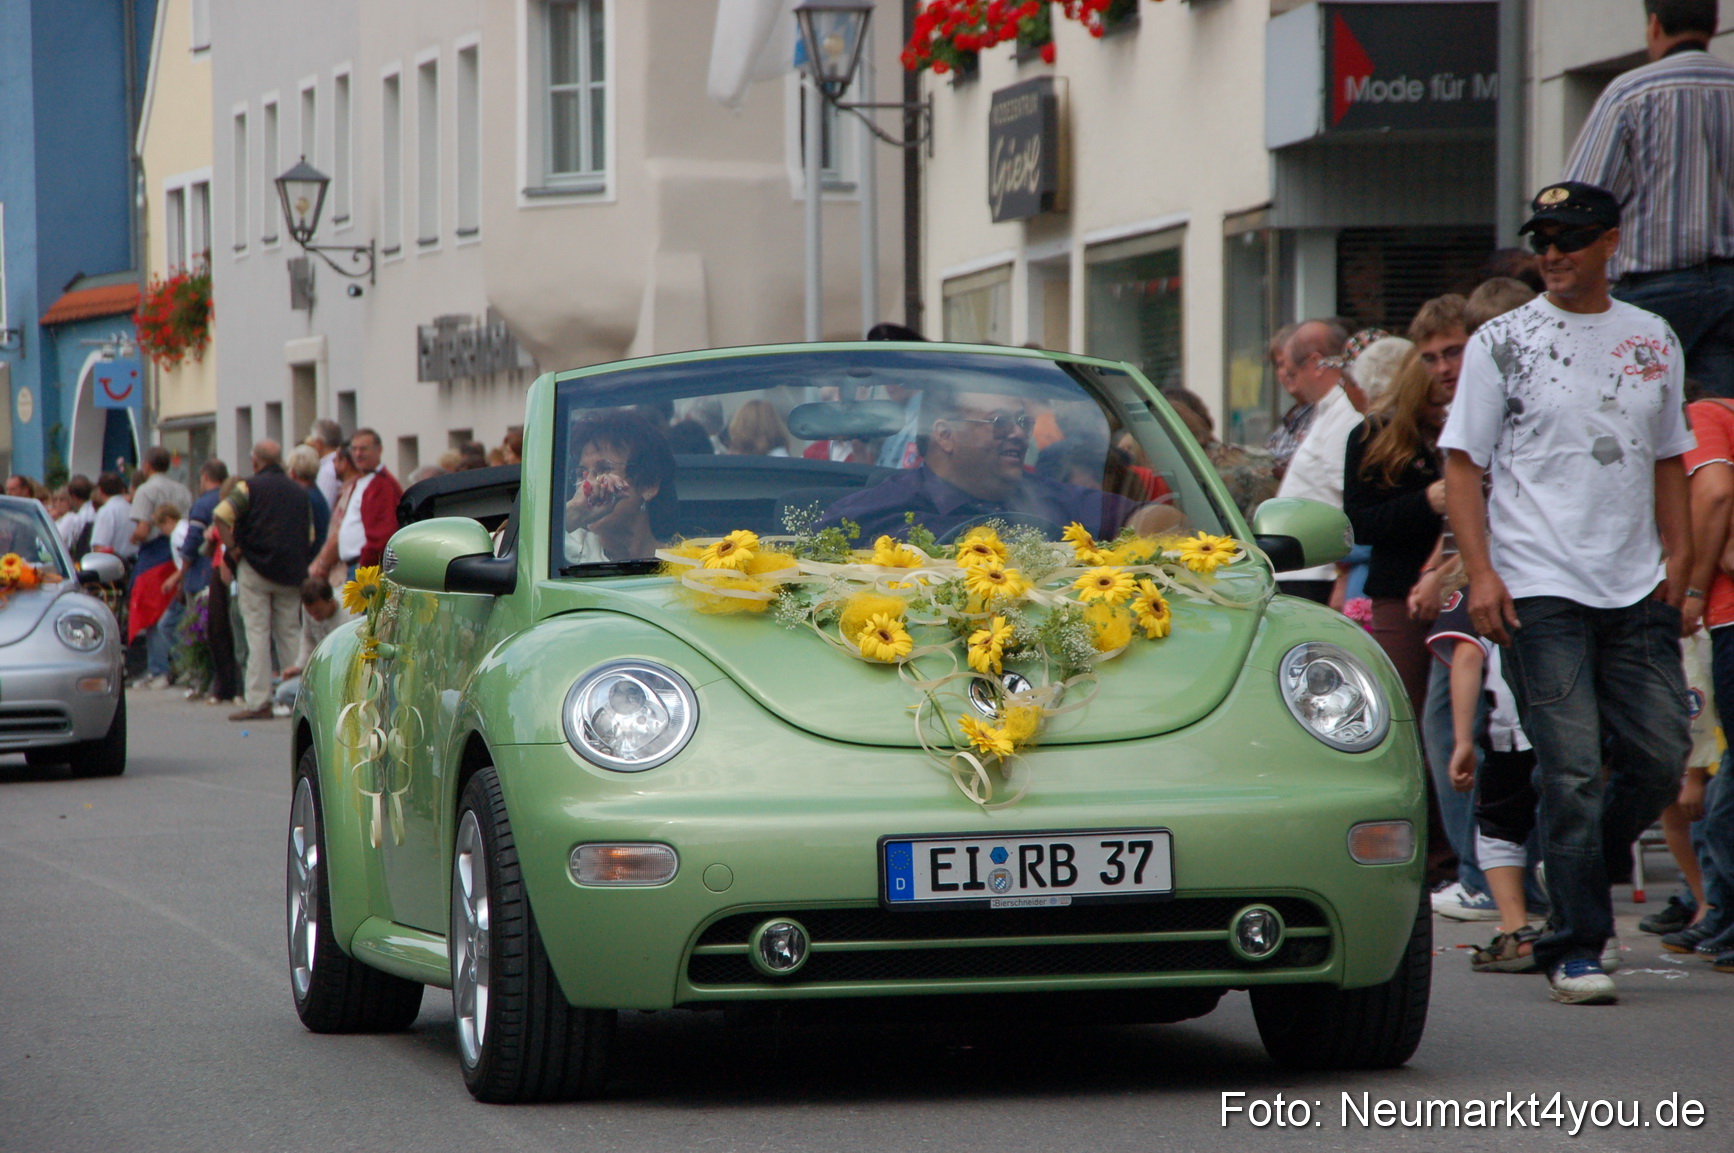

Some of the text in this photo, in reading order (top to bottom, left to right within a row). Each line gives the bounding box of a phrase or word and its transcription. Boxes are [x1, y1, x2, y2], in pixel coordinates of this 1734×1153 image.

[1346, 74, 1424, 102] Mode
[1431, 72, 1465, 99] für
[930, 840, 1153, 891] EI RB 37
[896, 877, 906, 890] D
[995, 898, 1047, 907] Bierschneider
